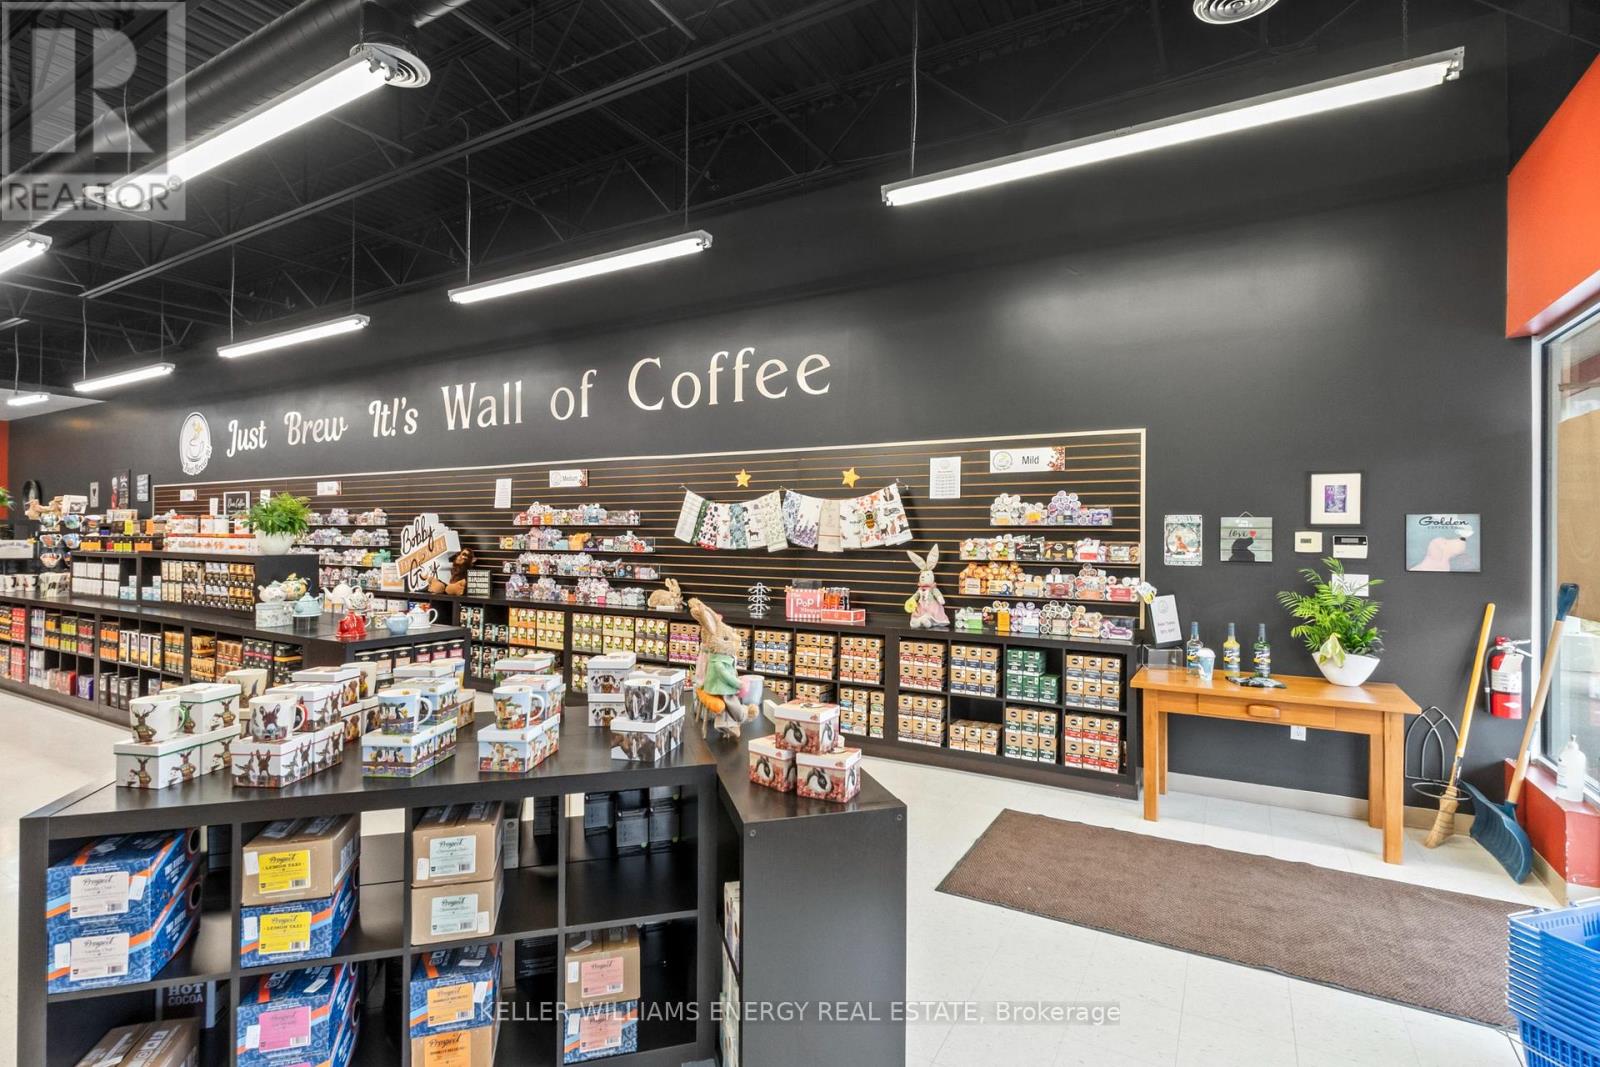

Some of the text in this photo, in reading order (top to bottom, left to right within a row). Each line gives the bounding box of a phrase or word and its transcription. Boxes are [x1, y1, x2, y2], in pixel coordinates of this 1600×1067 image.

[226, 419, 267, 458] Just
[284, 411, 349, 446] Brew
[441, 379, 523, 431] Wall
[550, 369, 597, 421] of
[628, 347, 831, 411] Coffee
[1021, 456, 1039, 465] Mild
[1418, 516, 1469, 526] Golden
[402, 516, 435, 555] Bobby
[168, 983, 205, 997] HOT
[168, 994, 204, 1006] COCOA
